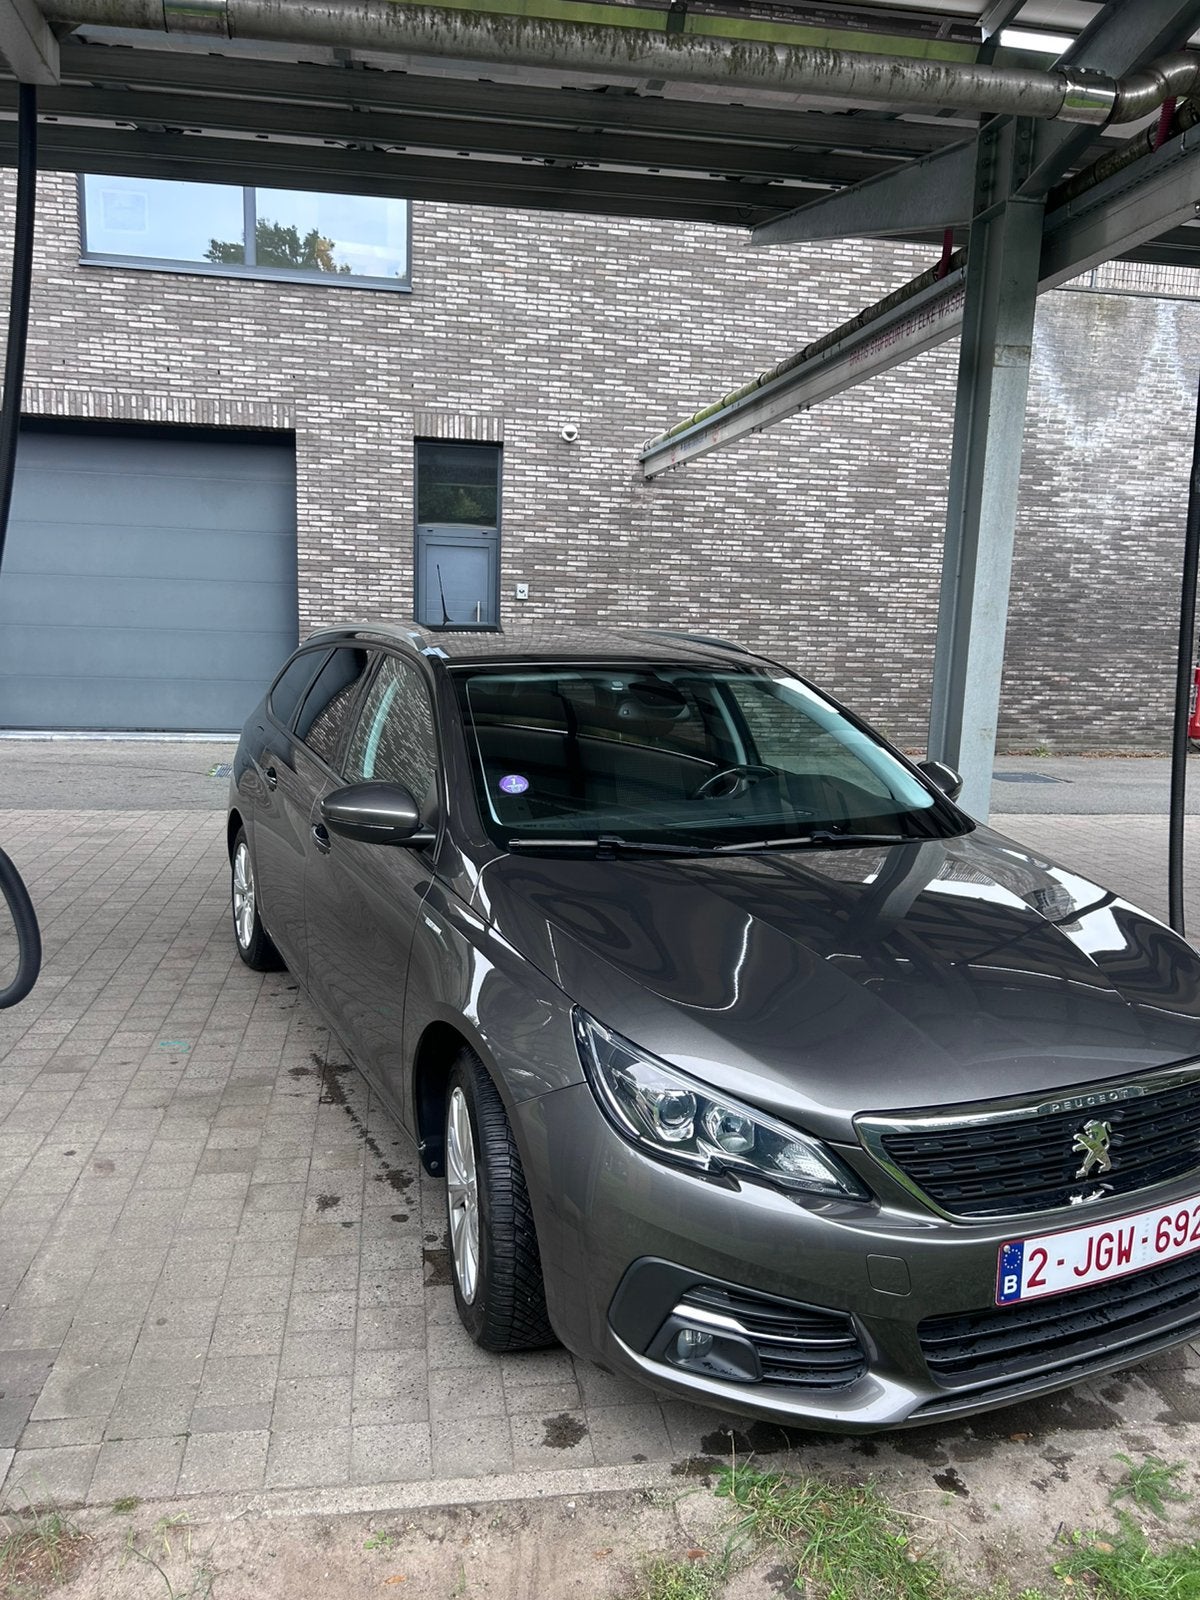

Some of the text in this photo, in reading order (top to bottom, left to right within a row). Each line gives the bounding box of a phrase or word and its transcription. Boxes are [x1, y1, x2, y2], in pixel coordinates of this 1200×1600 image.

[906, 316, 917, 337] BIJ
[918, 306, 936, 330] ELKE
[1051, 1089, 1128, 1112] PEUGEOT
[1003, 1274, 1018, 1295] B
